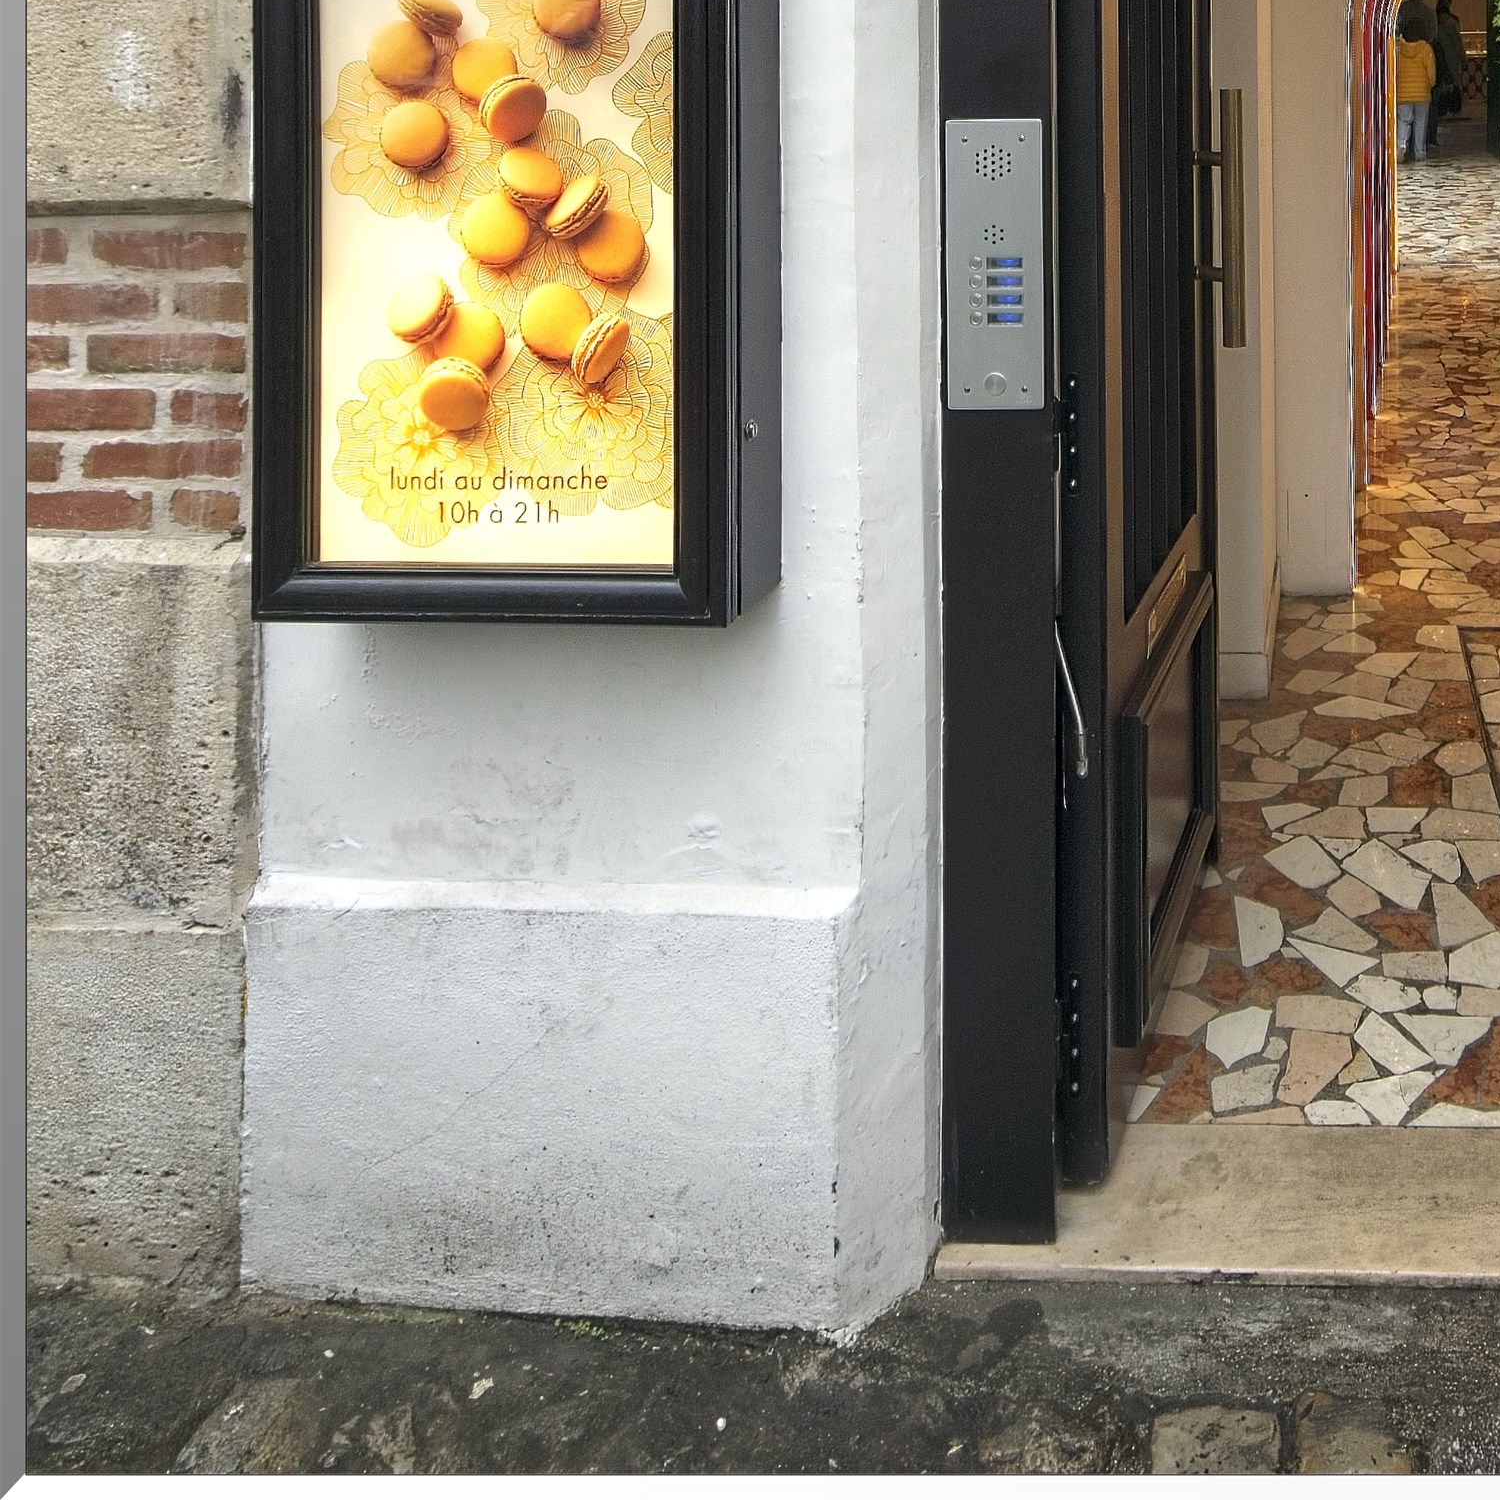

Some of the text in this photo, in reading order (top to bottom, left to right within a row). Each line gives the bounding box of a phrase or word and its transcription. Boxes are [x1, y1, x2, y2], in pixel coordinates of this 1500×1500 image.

[390, 466, 608, 490] lundi au dimanche
[439, 501, 559, 524] 10h à 21h
